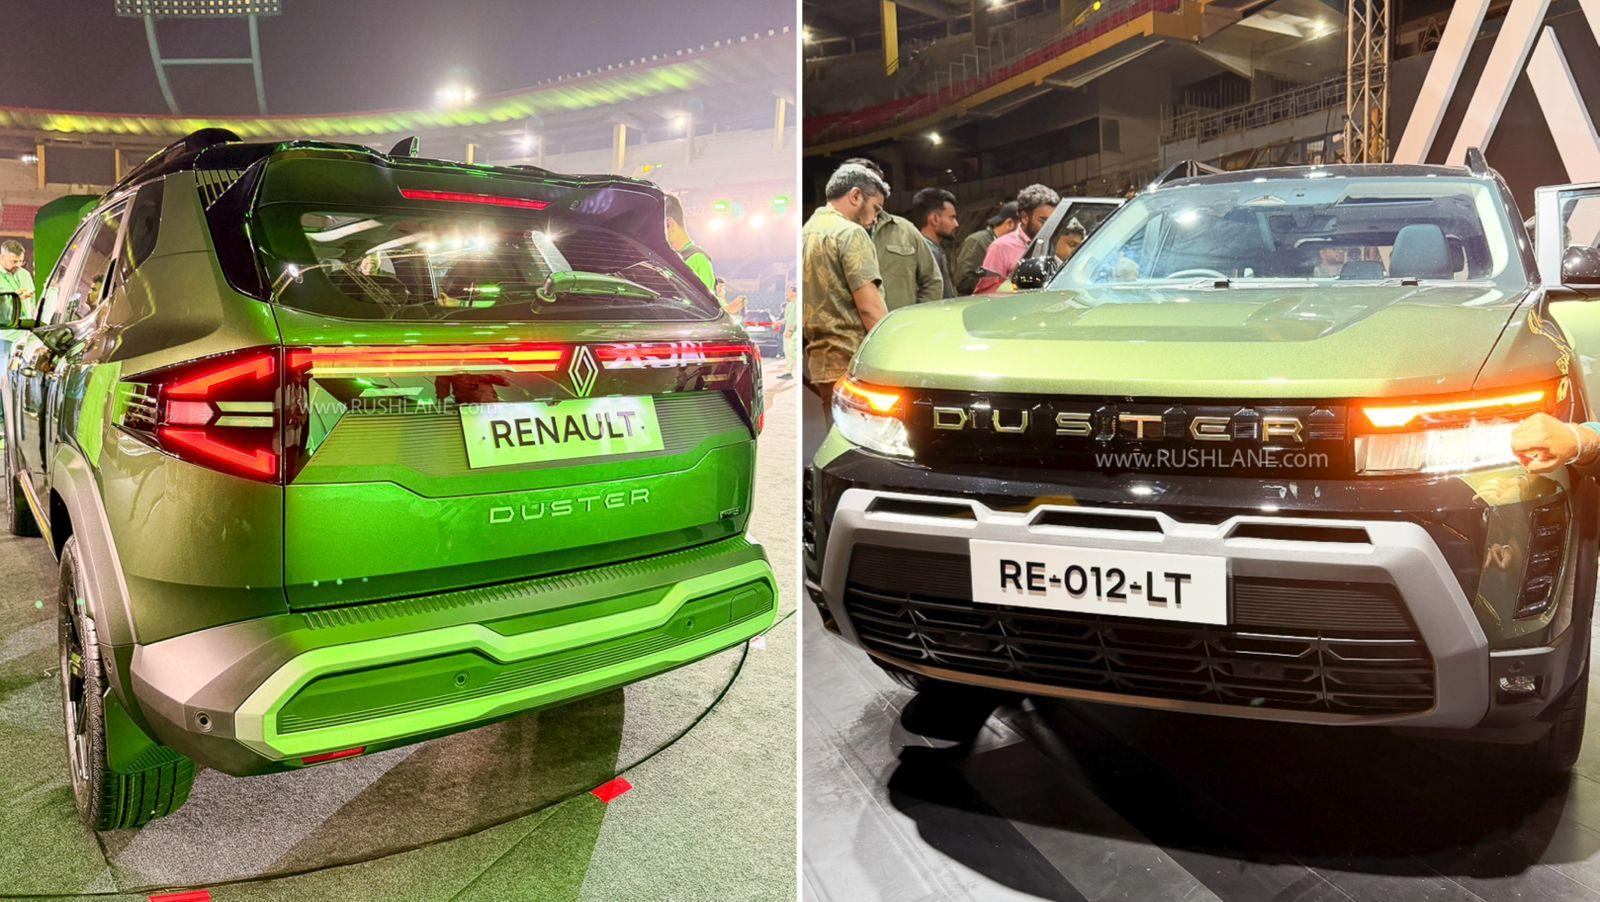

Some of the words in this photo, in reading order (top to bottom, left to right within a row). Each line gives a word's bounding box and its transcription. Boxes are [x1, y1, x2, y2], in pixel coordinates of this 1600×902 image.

[490, 411, 635, 448] RENAULT
[933, 406, 1303, 442] DUSTER
[490, 488, 650, 523] DUSTER
[999, 558, 1191, 604] RE-012-LT
